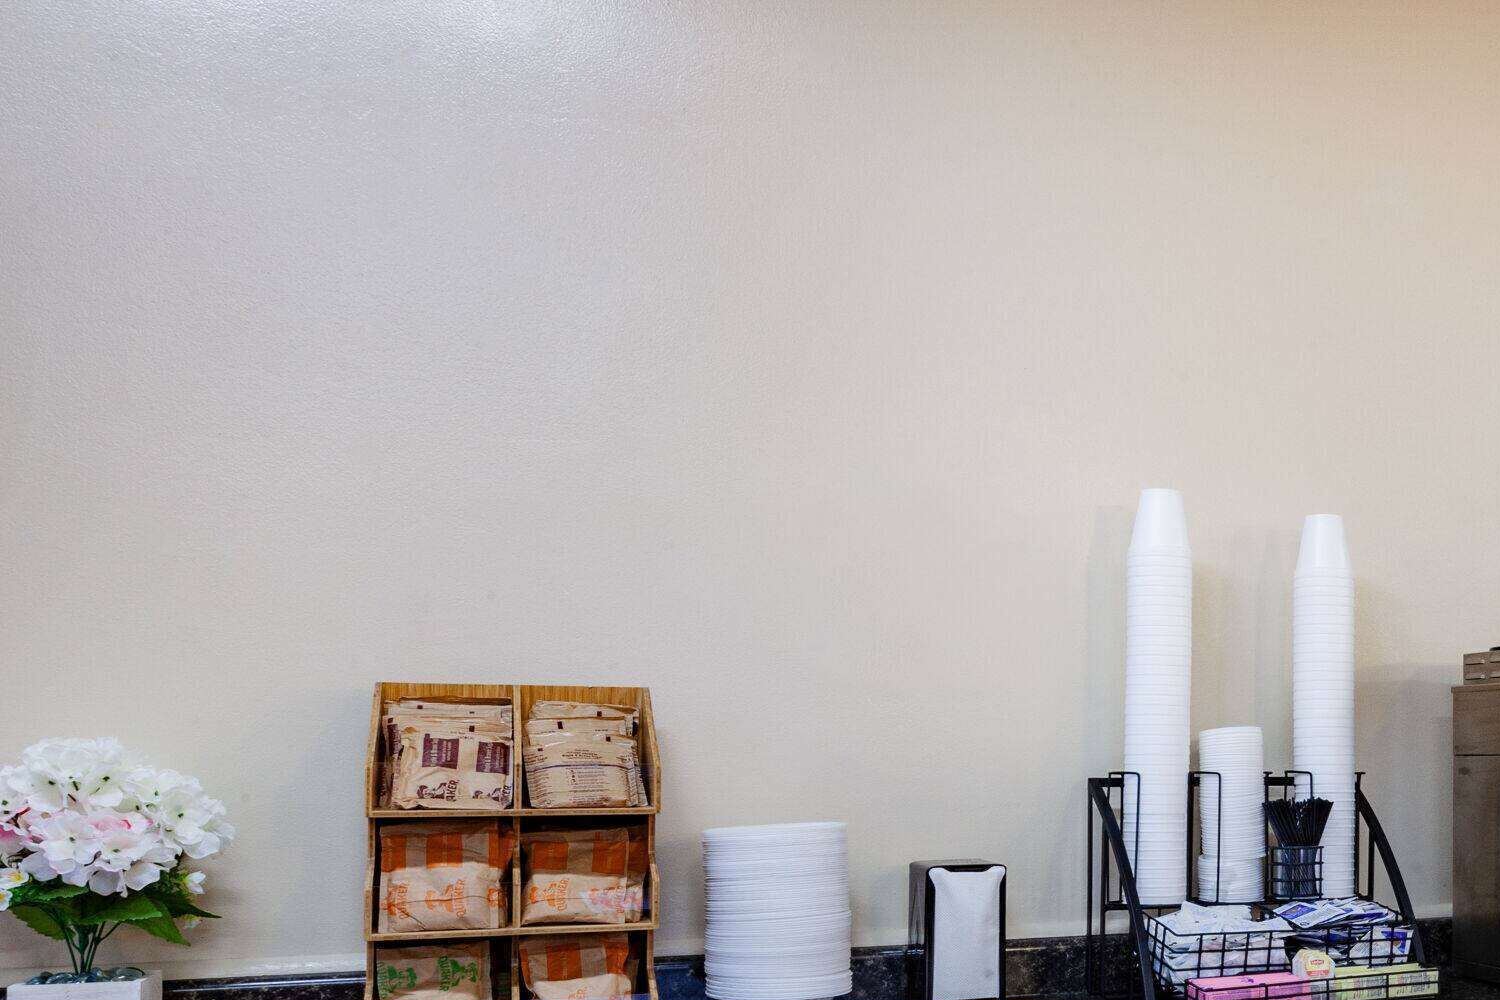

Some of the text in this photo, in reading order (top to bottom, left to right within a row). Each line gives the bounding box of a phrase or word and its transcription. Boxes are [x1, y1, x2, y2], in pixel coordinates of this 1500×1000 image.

[445, 779, 459, 802] AKER
[455, 879, 466, 918] QUAKER
[556, 878, 570, 912] QUAKER
[439, 955, 451, 992] QUAKER
